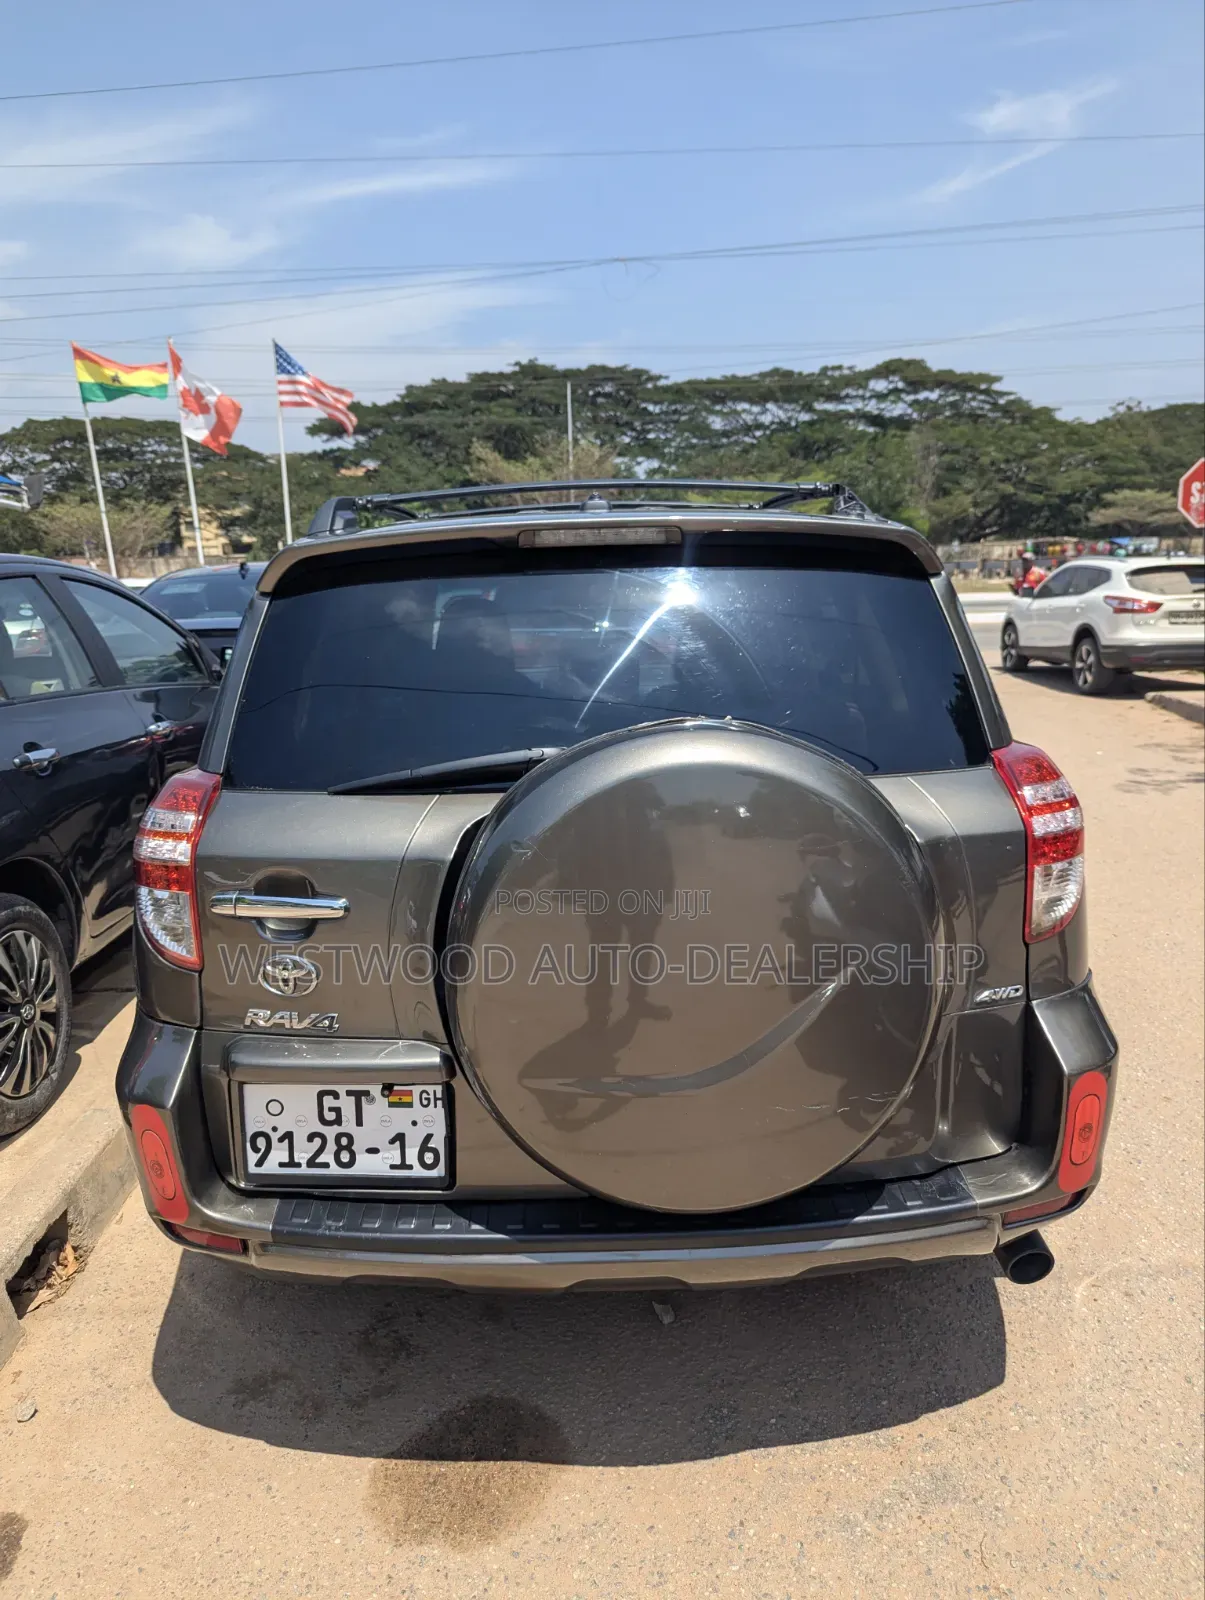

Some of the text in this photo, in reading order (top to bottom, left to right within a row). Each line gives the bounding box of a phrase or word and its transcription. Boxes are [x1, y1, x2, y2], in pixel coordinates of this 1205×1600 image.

[243, 1008, 340, 1033] RAV4
[316, 1089, 371, 1127] GT
[419, 1089, 444, 1109] GH
[249, 1130, 441, 1171] 9128-16
